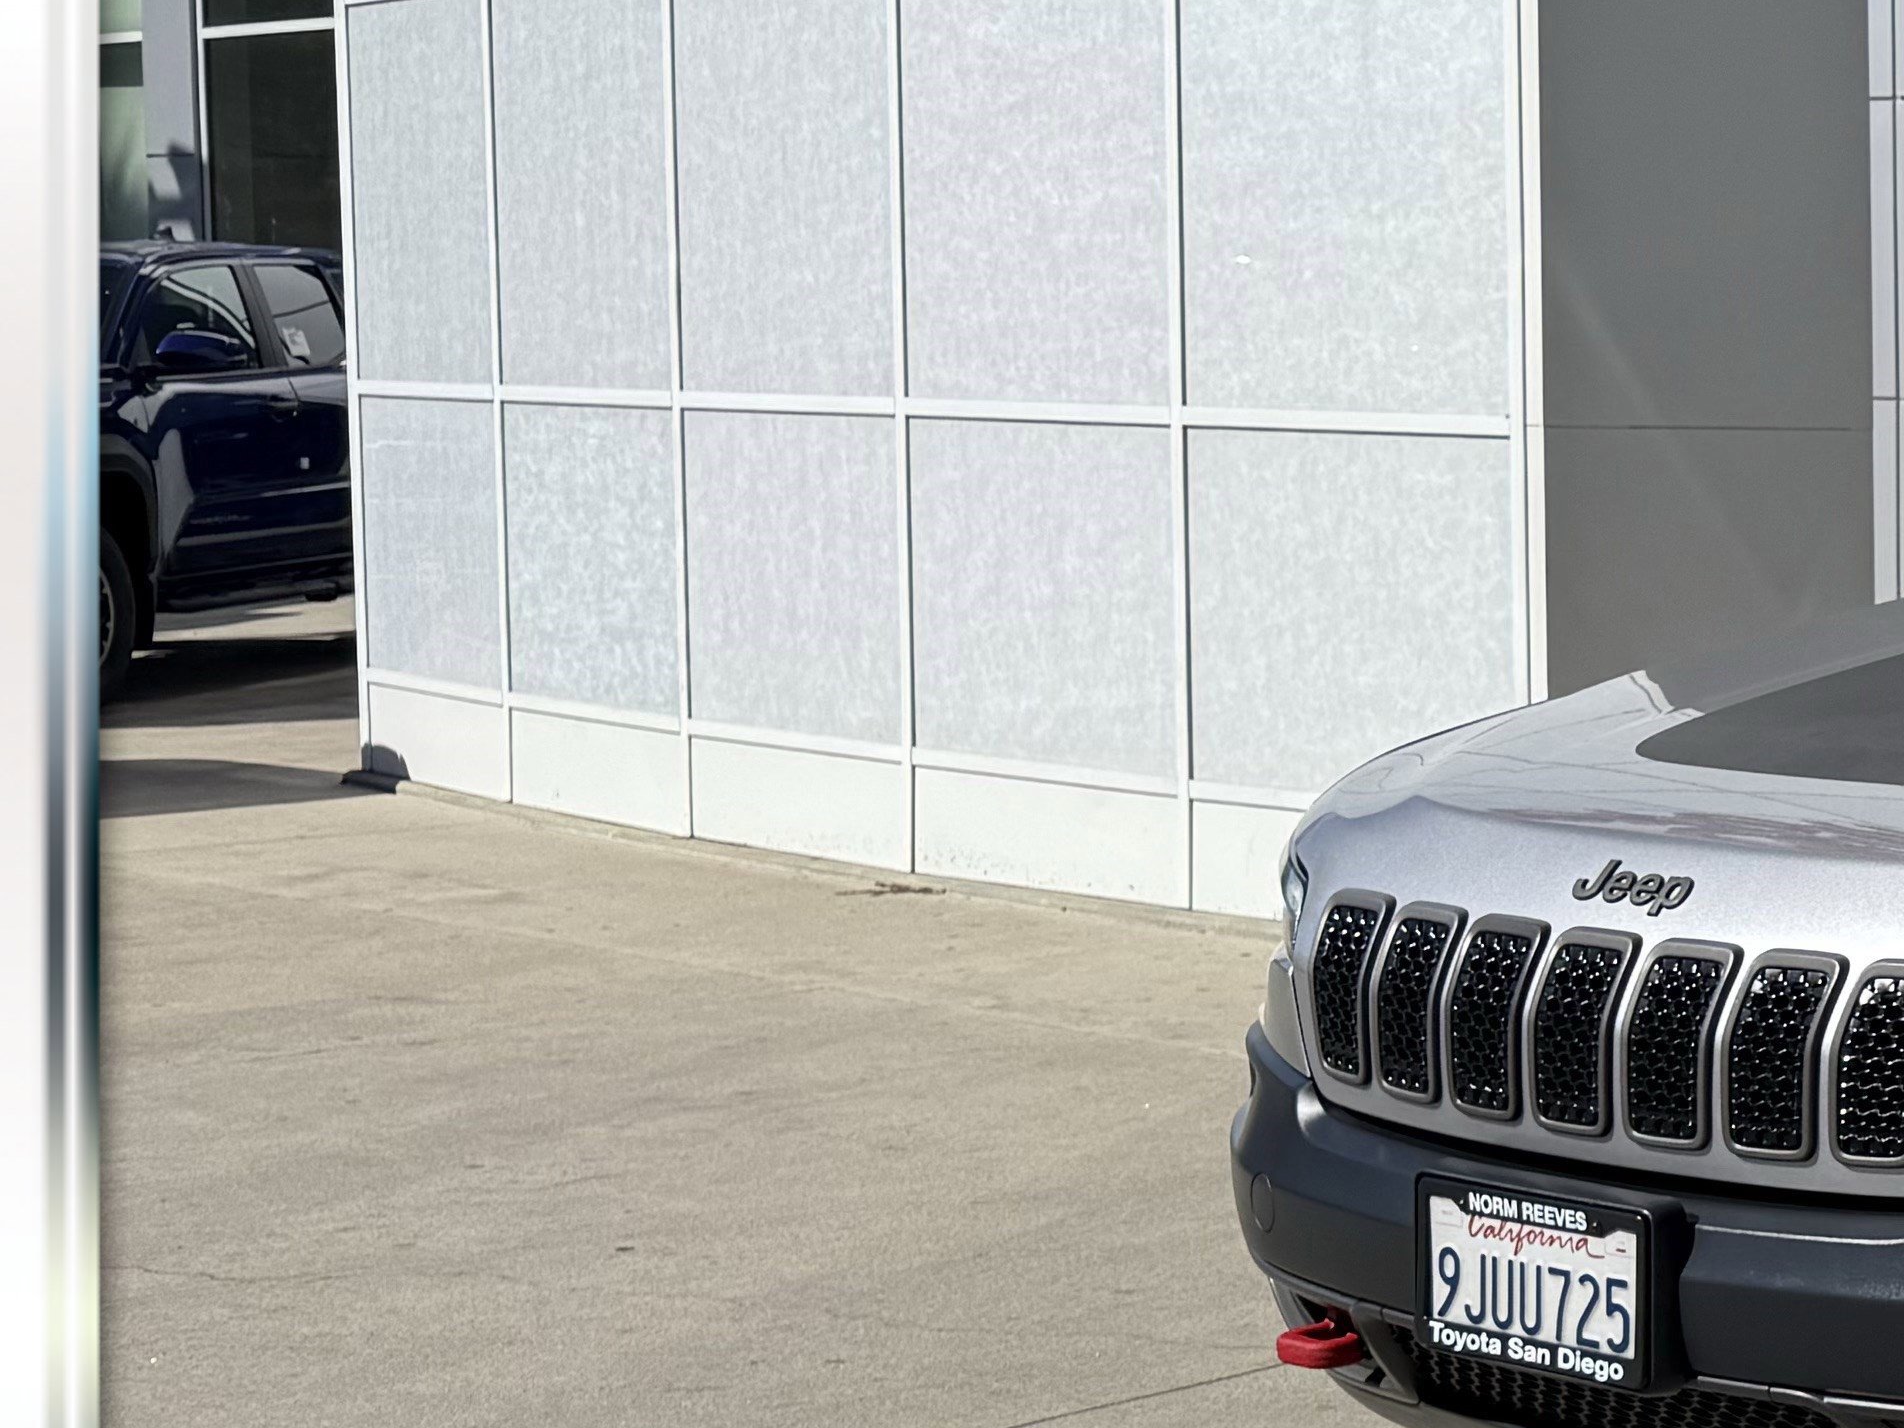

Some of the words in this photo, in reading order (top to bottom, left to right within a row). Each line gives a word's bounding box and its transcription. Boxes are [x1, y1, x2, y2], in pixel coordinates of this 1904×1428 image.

[1572, 858, 1695, 917] Jeep
[1468, 1191, 1518, 1220] NORM
[1521, 1200, 1588, 1232] REEVES
[1468, 1214, 1605, 1259] California
[1437, 1245, 1631, 1354] 9JUU725
[1429, 1320, 1501, 1356] Toyota
[1508, 1338, 1551, 1366] San
[1557, 1347, 1625, 1383] Diego
